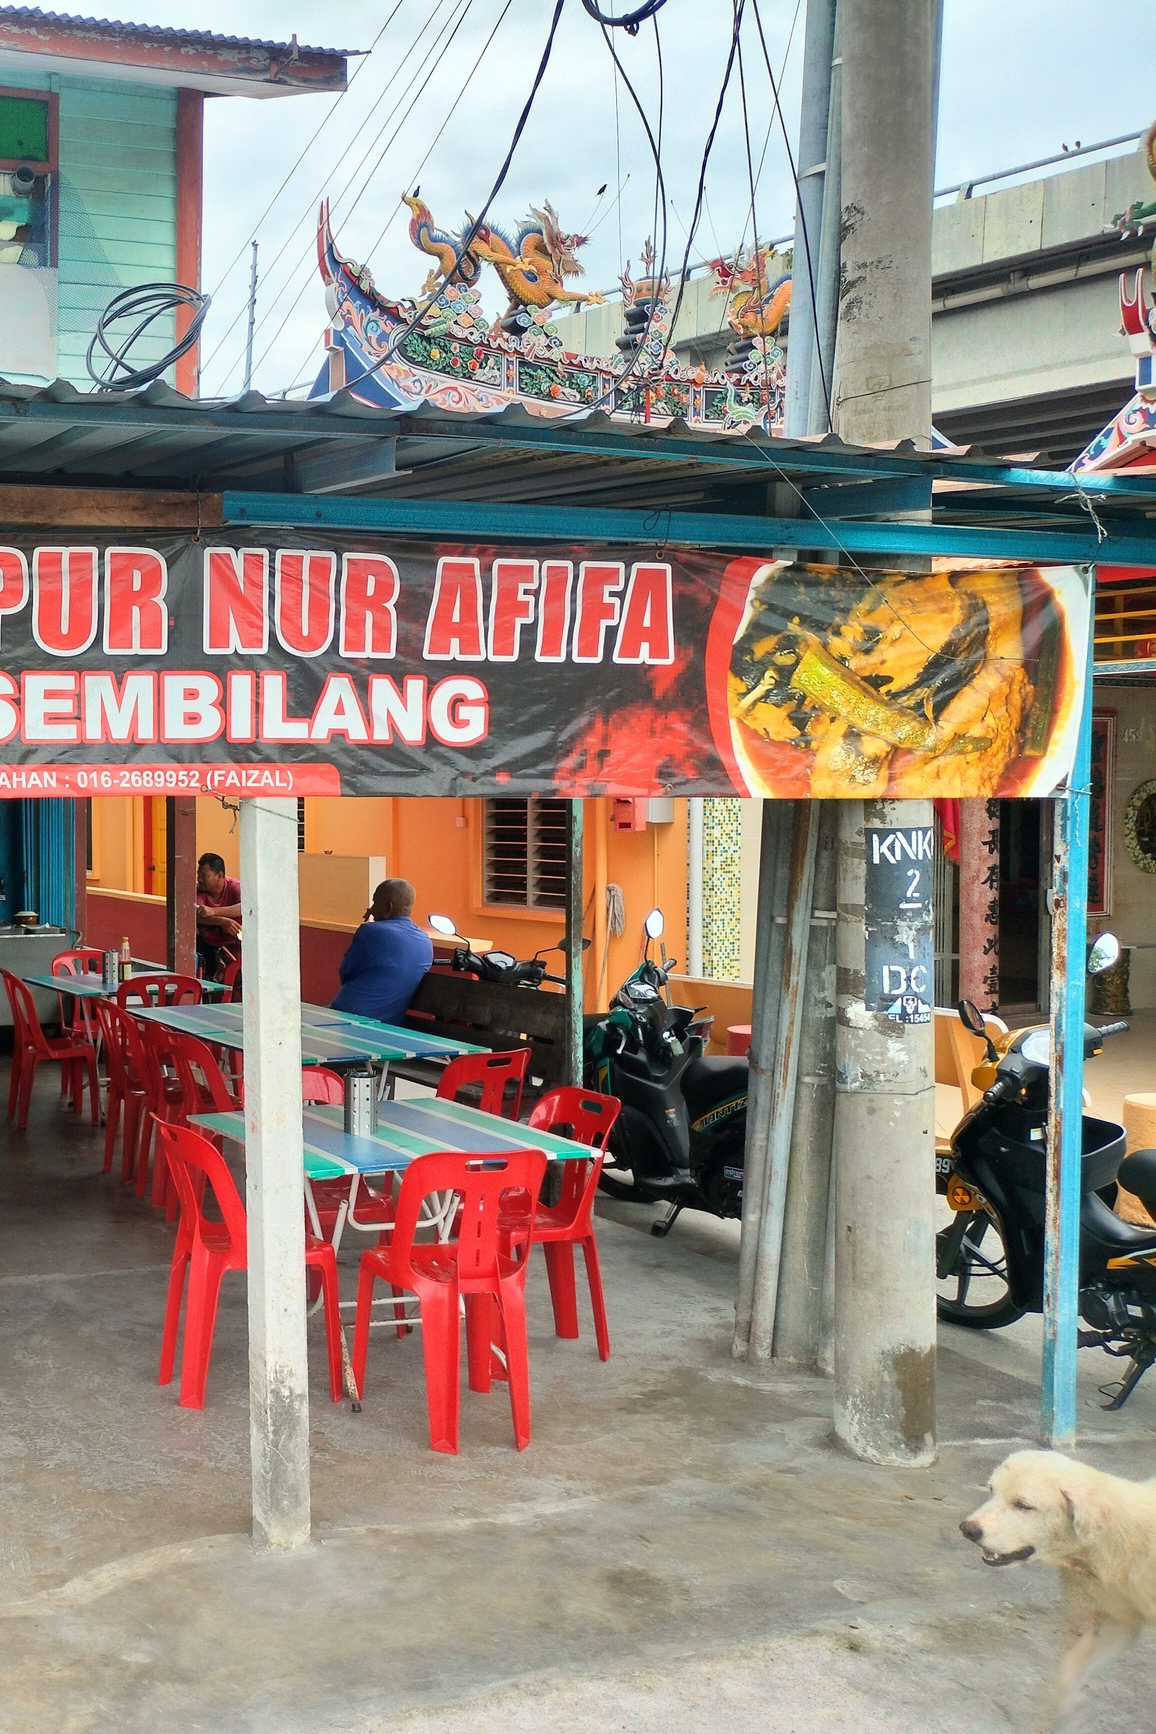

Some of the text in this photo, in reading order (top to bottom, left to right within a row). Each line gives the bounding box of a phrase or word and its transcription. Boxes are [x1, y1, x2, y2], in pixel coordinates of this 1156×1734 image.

[203, 546, 400, 660] NUR
[423, 556, 675, 665] AFIFA
[75, 769, 201, 789] 016-2689952
[205, 768, 294, 790] (FAIZAL)
[872, 830, 933, 864] KNK
[906, 868, 921, 898] 2
